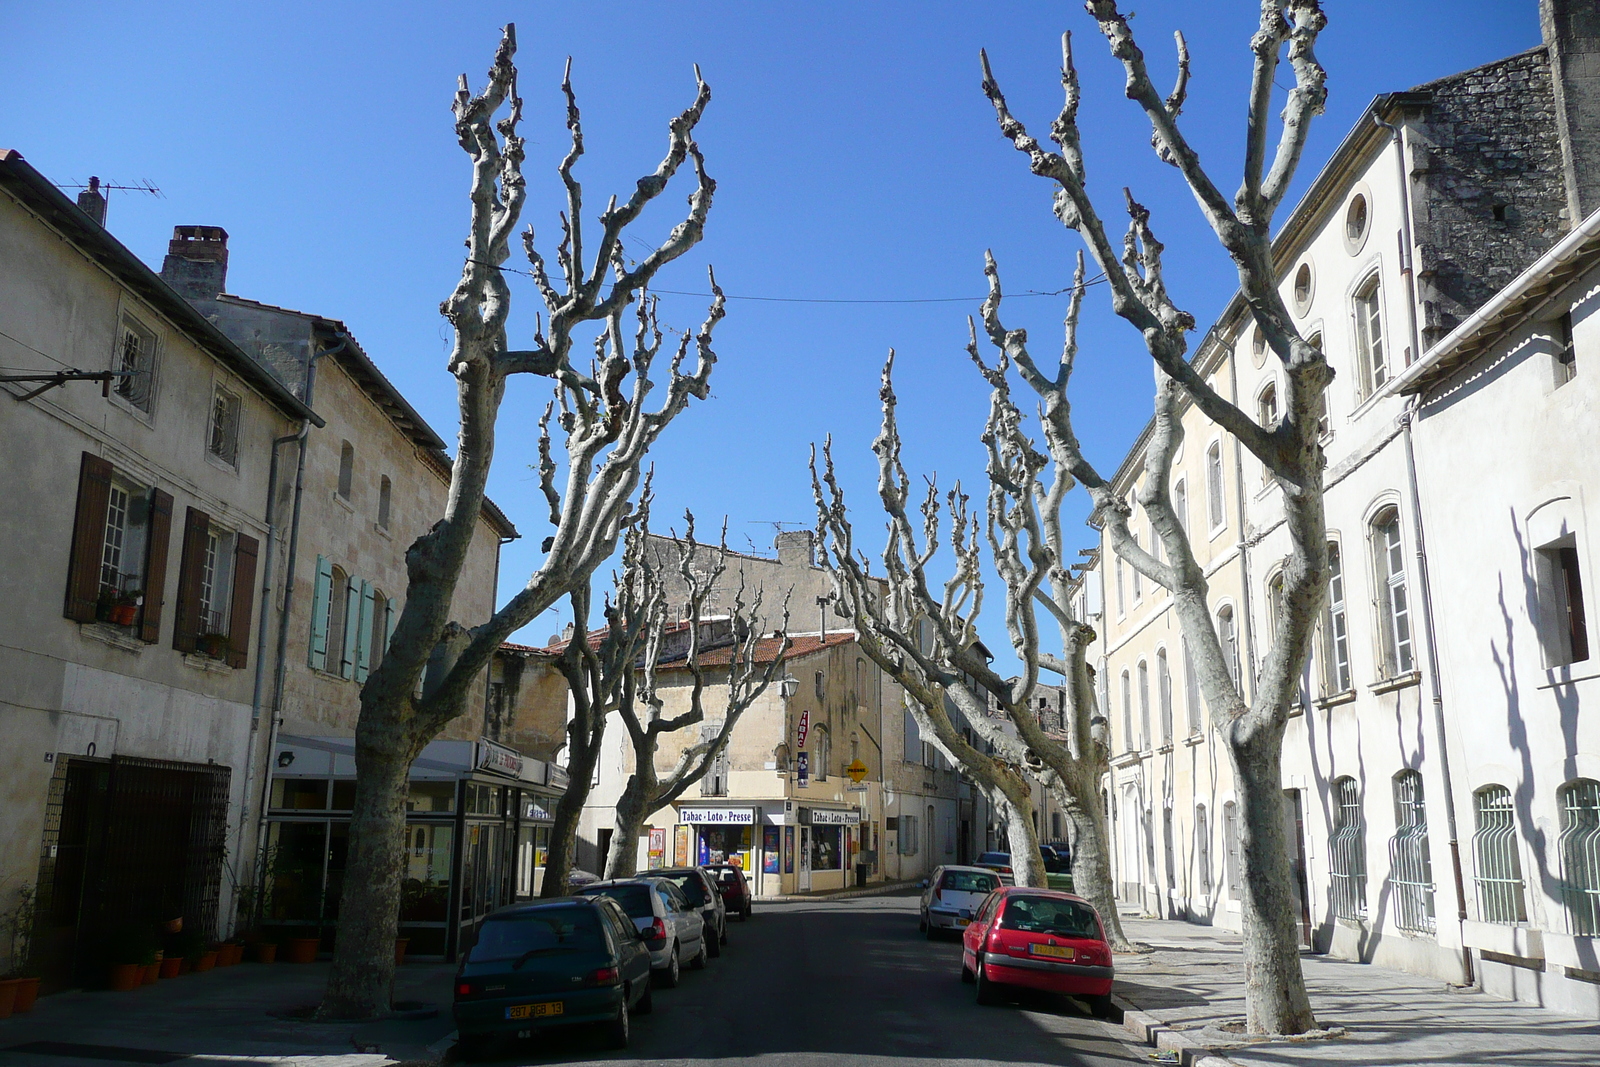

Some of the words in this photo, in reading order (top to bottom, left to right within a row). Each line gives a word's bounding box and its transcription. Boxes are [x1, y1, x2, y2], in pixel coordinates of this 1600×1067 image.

[798, 712, 808, 746] TABAC
[682, 811, 702, 822] Tabac
[707, 811, 723, 822] Loto
[728, 811, 751, 822] Presse
[814, 812, 828, 822] Tabac
[831, 813, 842, 823] Loto
[844, 814, 858, 823] Presse
[511, 1006, 526, 1017] 287
[552, 1003, 561, 1013] 13
